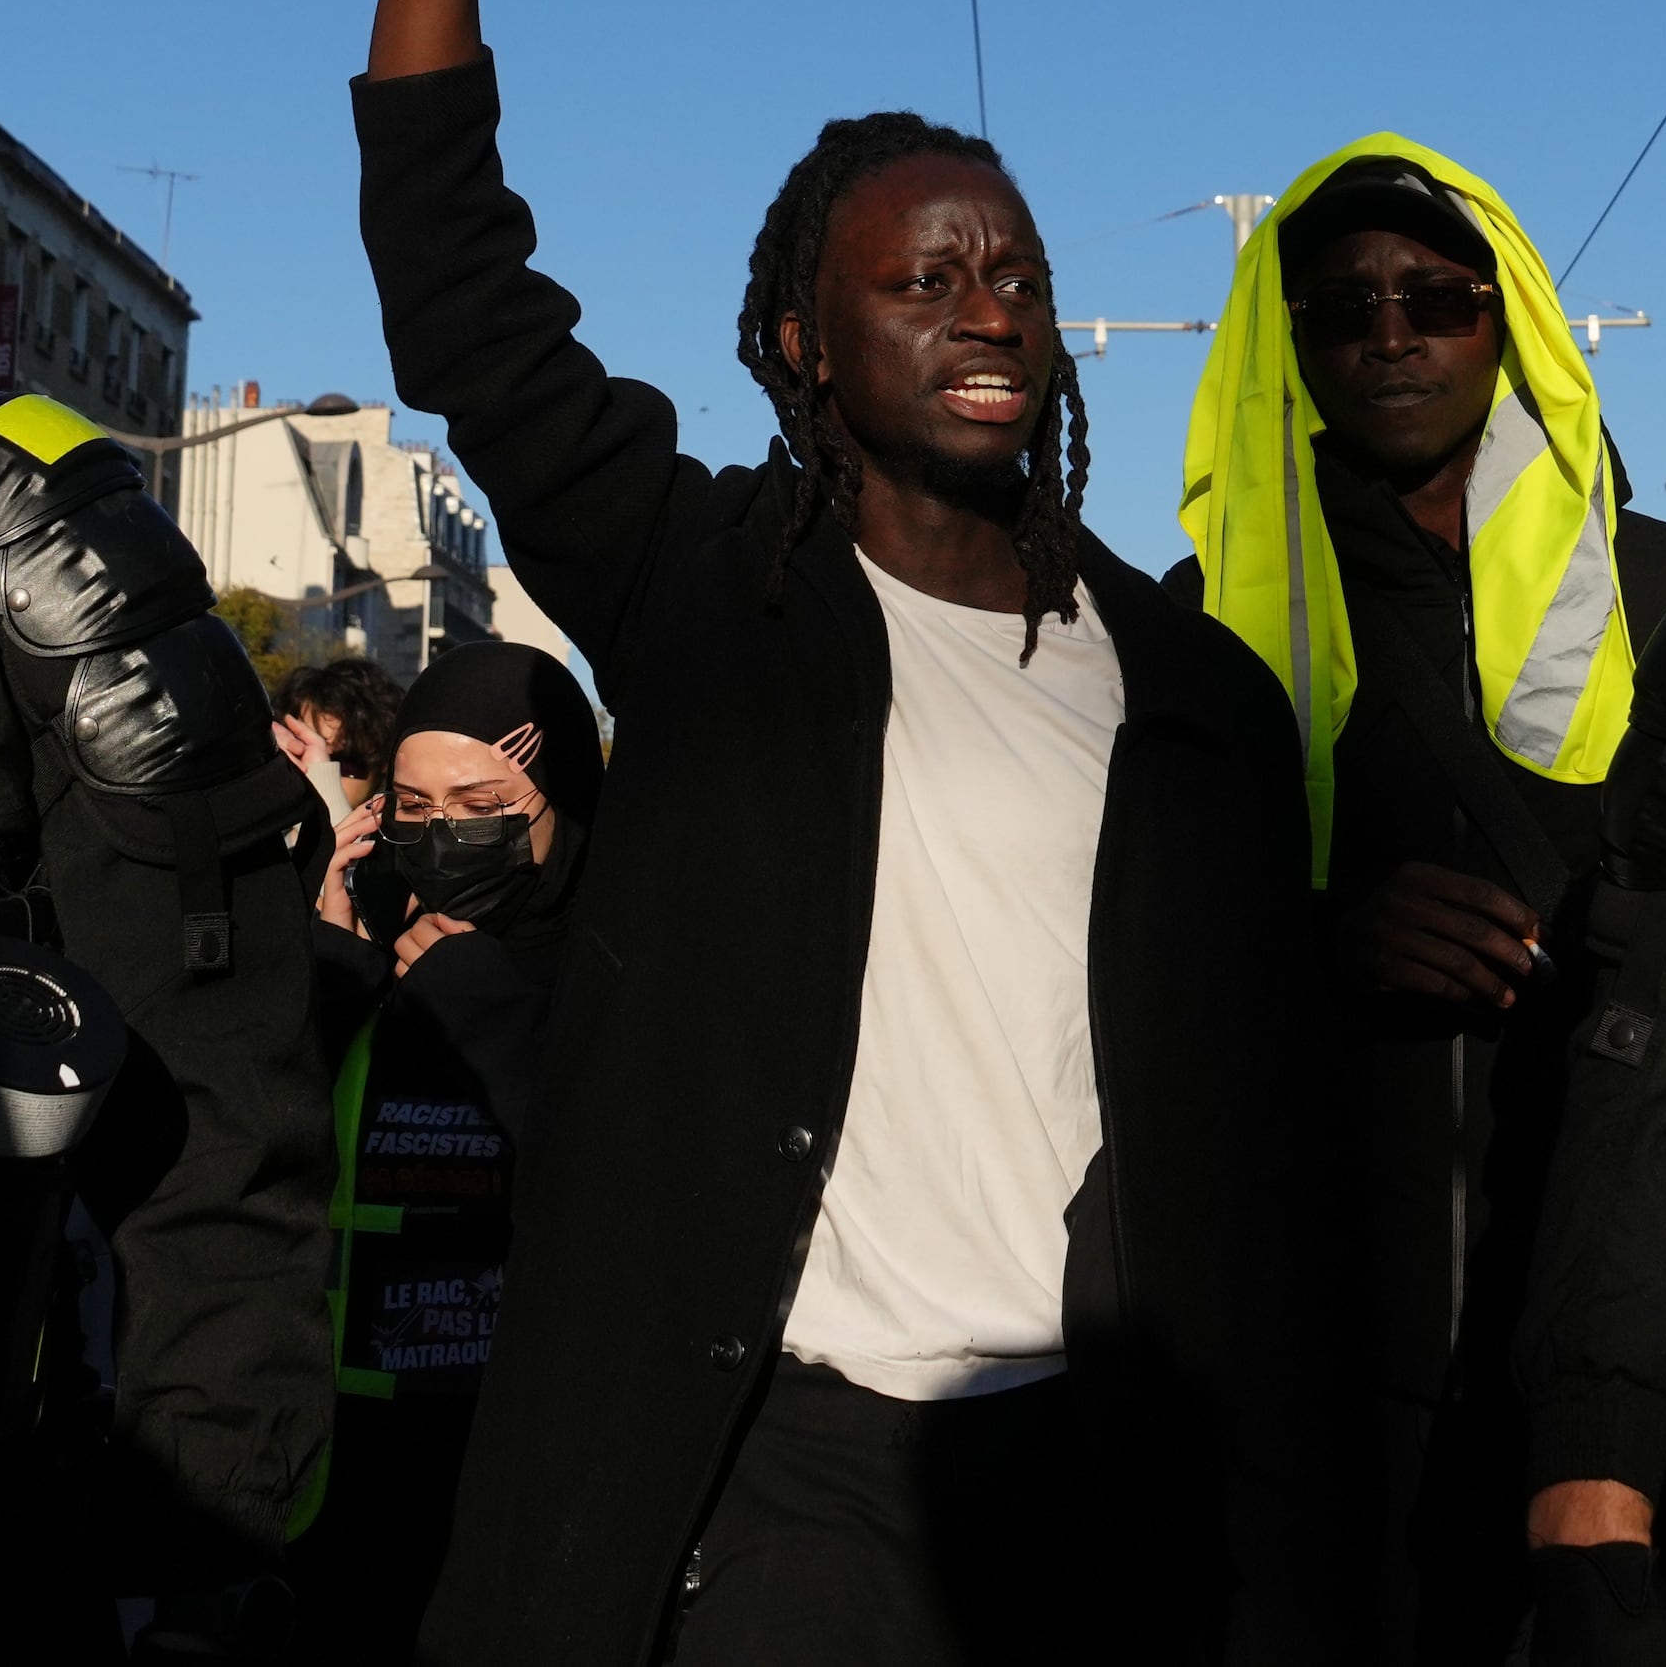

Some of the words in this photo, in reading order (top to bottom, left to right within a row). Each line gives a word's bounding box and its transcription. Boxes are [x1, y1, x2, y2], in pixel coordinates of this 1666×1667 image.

[364, 1131, 502, 1158] FASCISTES
[384, 1283, 413, 1310] LE
[422, 1308, 473, 1336] PAS
